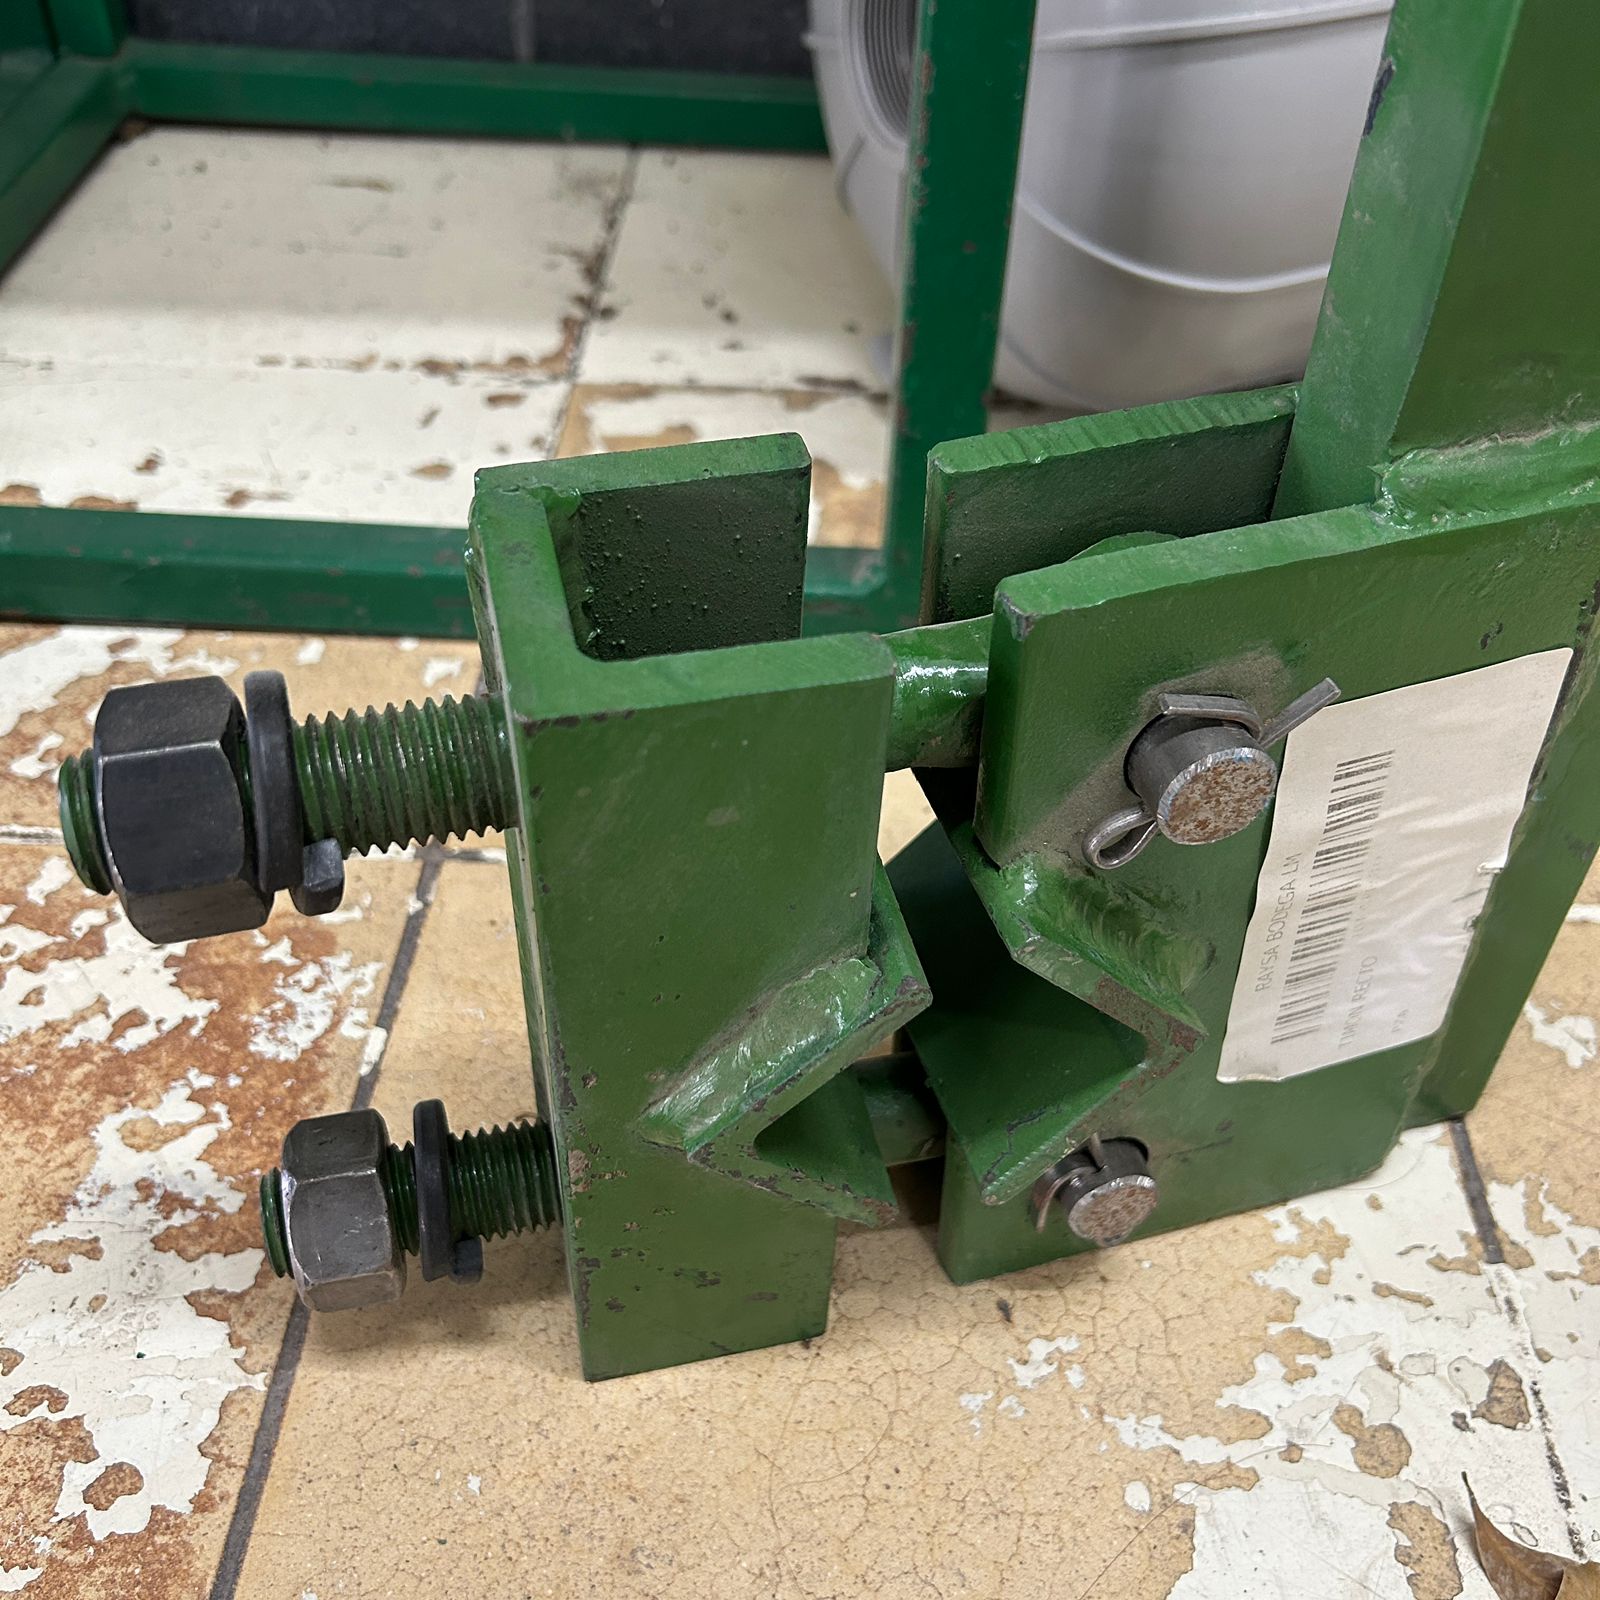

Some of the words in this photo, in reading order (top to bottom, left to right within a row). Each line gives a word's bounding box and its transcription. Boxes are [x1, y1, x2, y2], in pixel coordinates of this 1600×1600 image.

[1281, 852, 1302, 876] LM
[1265, 878, 1296, 942] BODEGA
[1254, 944, 1280, 992] RAYSA
[1352, 956, 1377, 1002] RECTO
